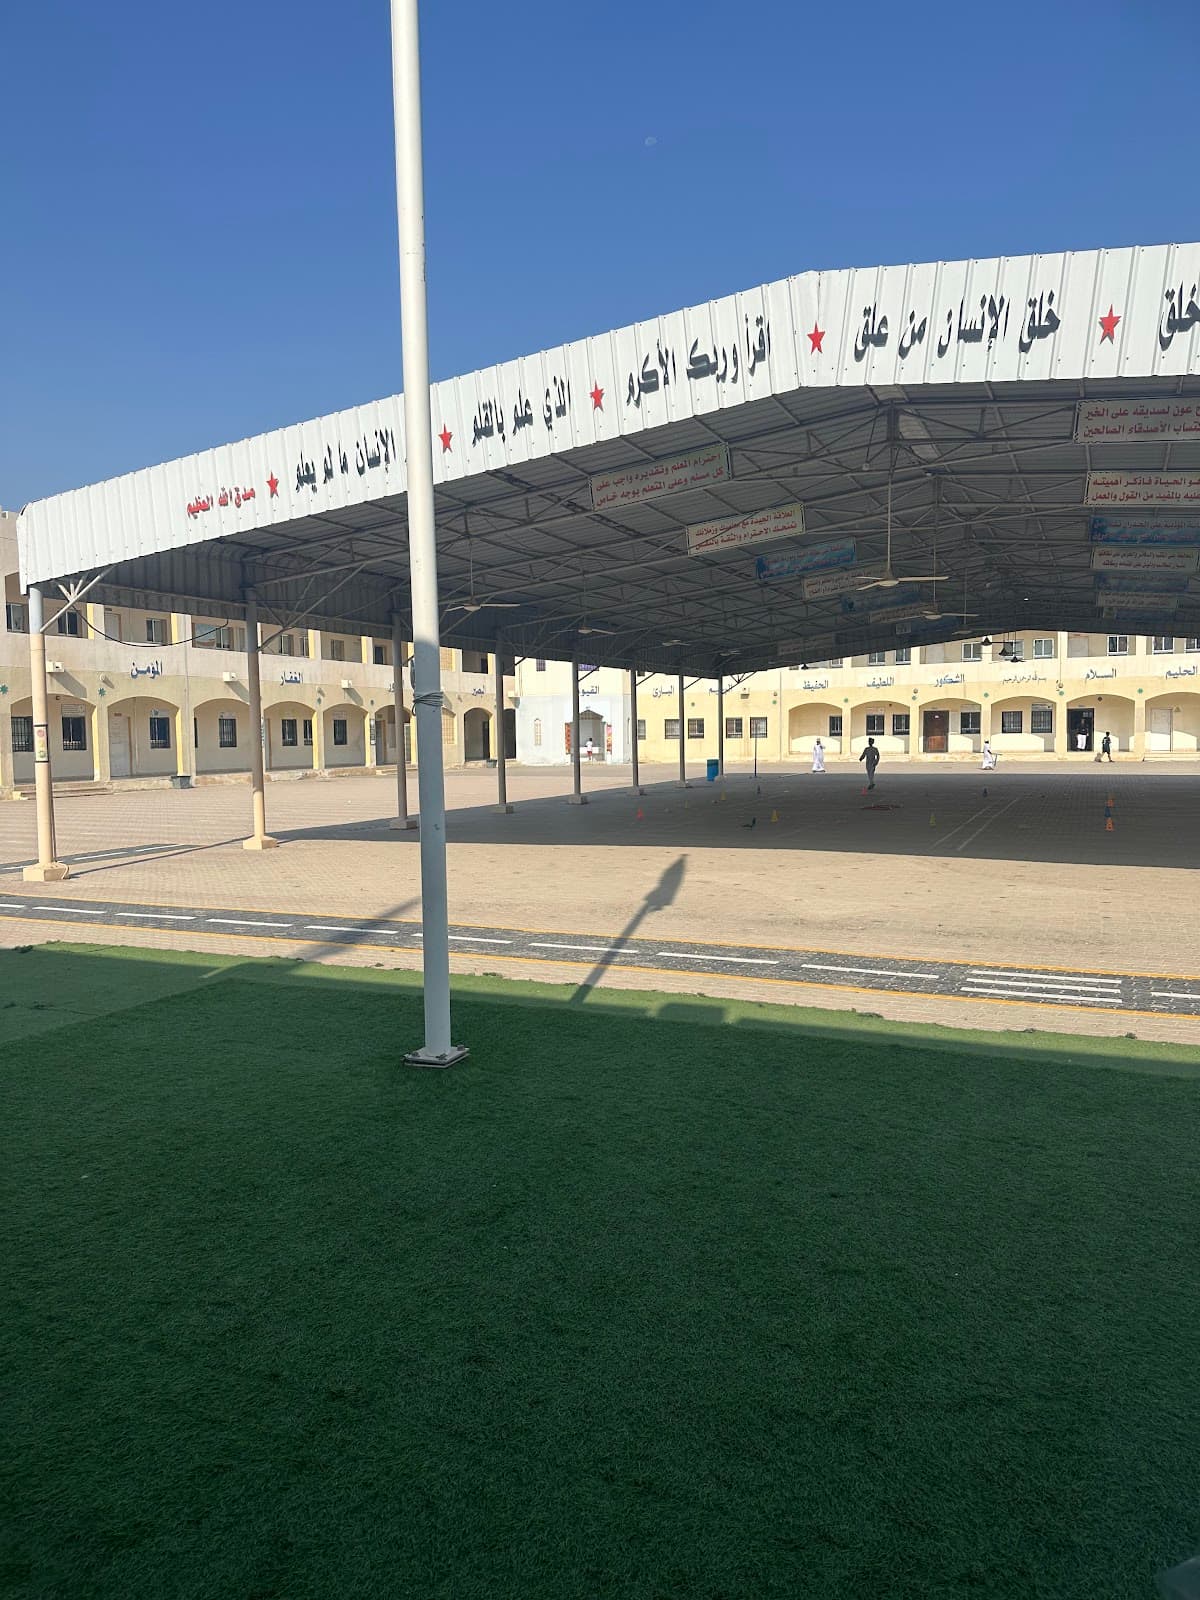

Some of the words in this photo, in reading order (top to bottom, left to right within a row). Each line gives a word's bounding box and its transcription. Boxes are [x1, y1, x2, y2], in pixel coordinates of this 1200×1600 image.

[937, 293, 1011, 359] الإنسان
[1018, 289, 1061, 354] خلق
[1158, 280, 1200, 352] خلق
[853, 301, 889, 363] علق
[898, 309, 927, 361] من
[745, 313, 771, 377] اقرأ
[686, 337, 739, 384] وربك
[626, 338, 676, 409] الأكرم
[512, 387, 533, 437] علم
[542, 375, 571, 432] الذي
[1084, 407, 1109, 421] الخير
[1111, 407, 1129, 419] على
[472, 395, 505, 448] بالقلم
[1083, 424, 1125, 438] الصالحين
[1173, 421, 1200, 435] تساب
[323, 442, 334, 484] لم
[356, 427, 396, 477] الإنسان
[295, 449, 318, 494] يعلم
[186, 495, 213, 520] العظيم
[218, 486, 233, 507] الله
[234, 486, 256, 508] صدق
[130, 659, 163, 679] المؤمن
[280, 671, 304, 686] الغفار
[933, 673, 965, 687] الشكور
[1085, 667, 1117, 683] السلام
[1165, 665, 1198, 680] الحليم
[579, 684, 600, 697] القيو
[802, 680, 829, 692] الحفيظ
[866, 676, 895, 689] اللطيف
